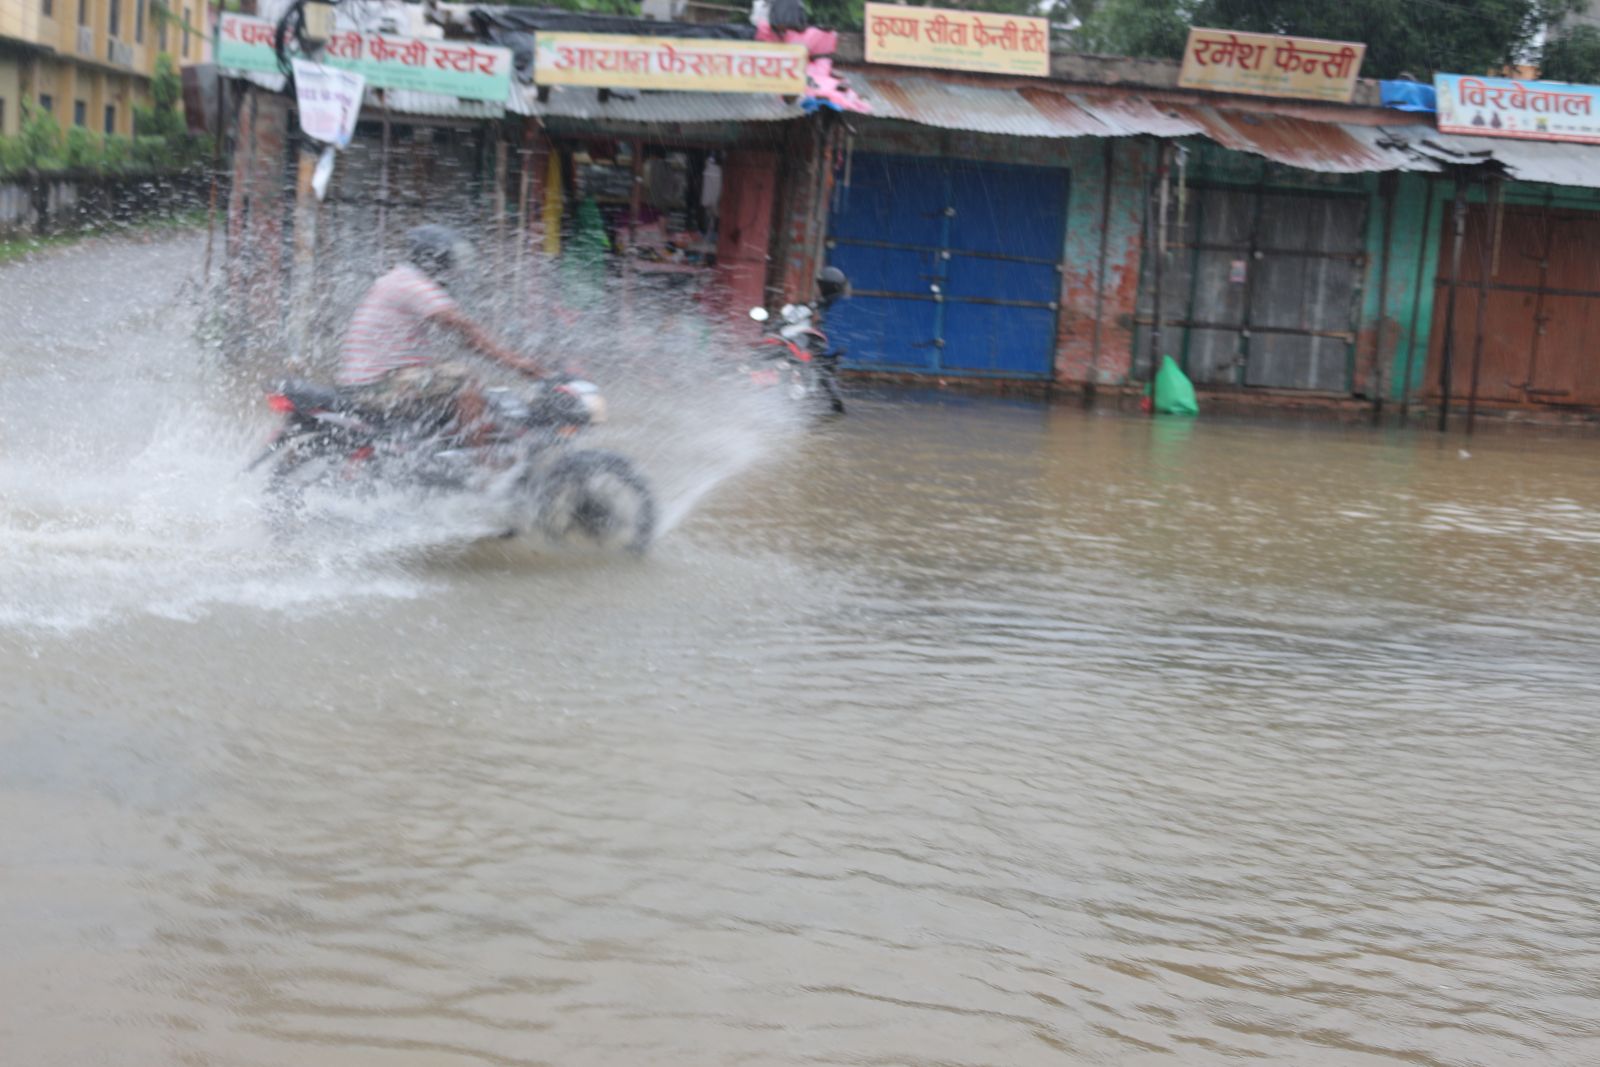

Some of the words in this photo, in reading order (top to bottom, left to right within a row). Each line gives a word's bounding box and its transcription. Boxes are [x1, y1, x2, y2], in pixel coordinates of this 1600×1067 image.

[925, 14, 968, 46] सीता
[370, 33, 428, 66] फेन्सी
[433, 47, 497, 75] स्टोर
[1194, 35, 1266, 70] रमेश
[1275, 41, 1357, 79] फेन्सी
